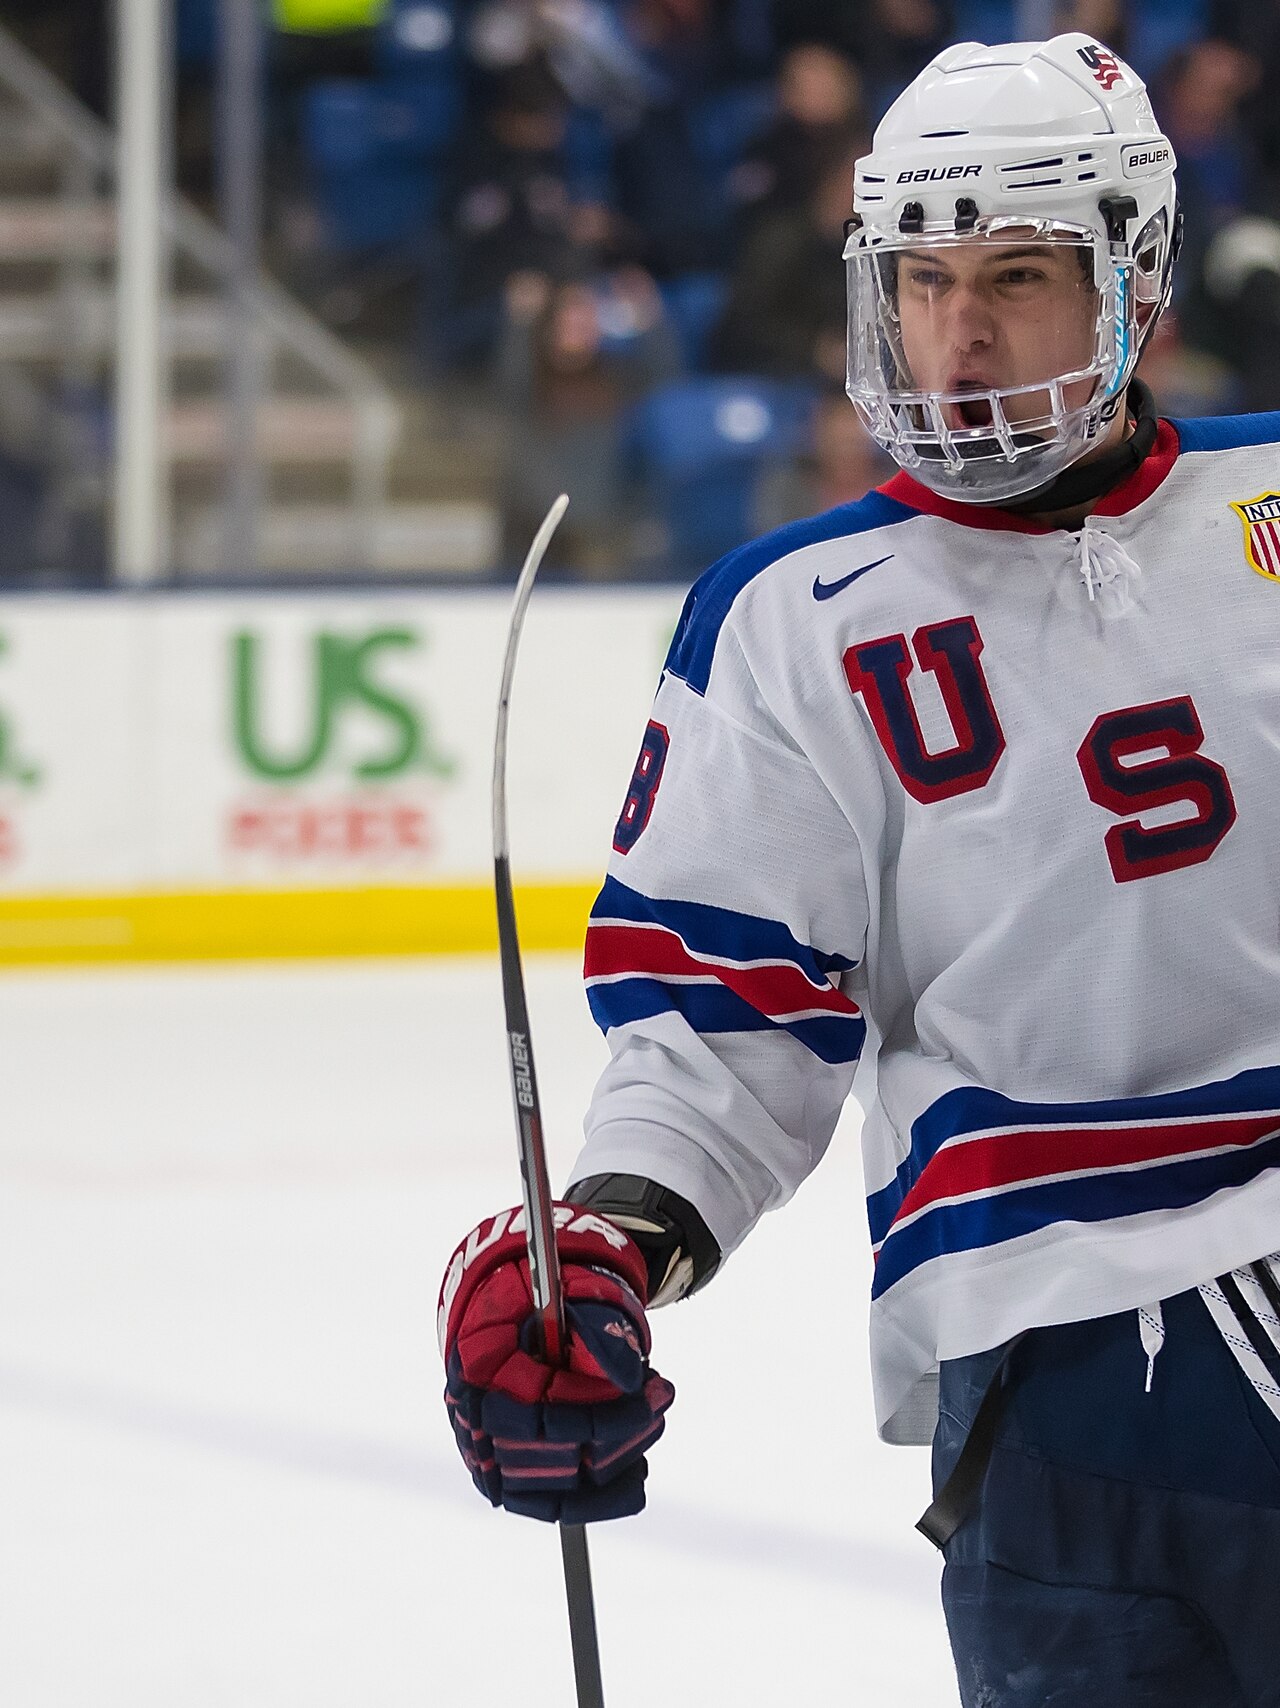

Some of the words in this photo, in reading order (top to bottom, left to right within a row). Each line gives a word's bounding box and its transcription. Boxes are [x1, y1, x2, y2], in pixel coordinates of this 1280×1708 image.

[1128, 148, 1170, 168] BAUER
[896, 164, 983, 185] BAUER
[511, 1032, 534, 1108] BAUER
